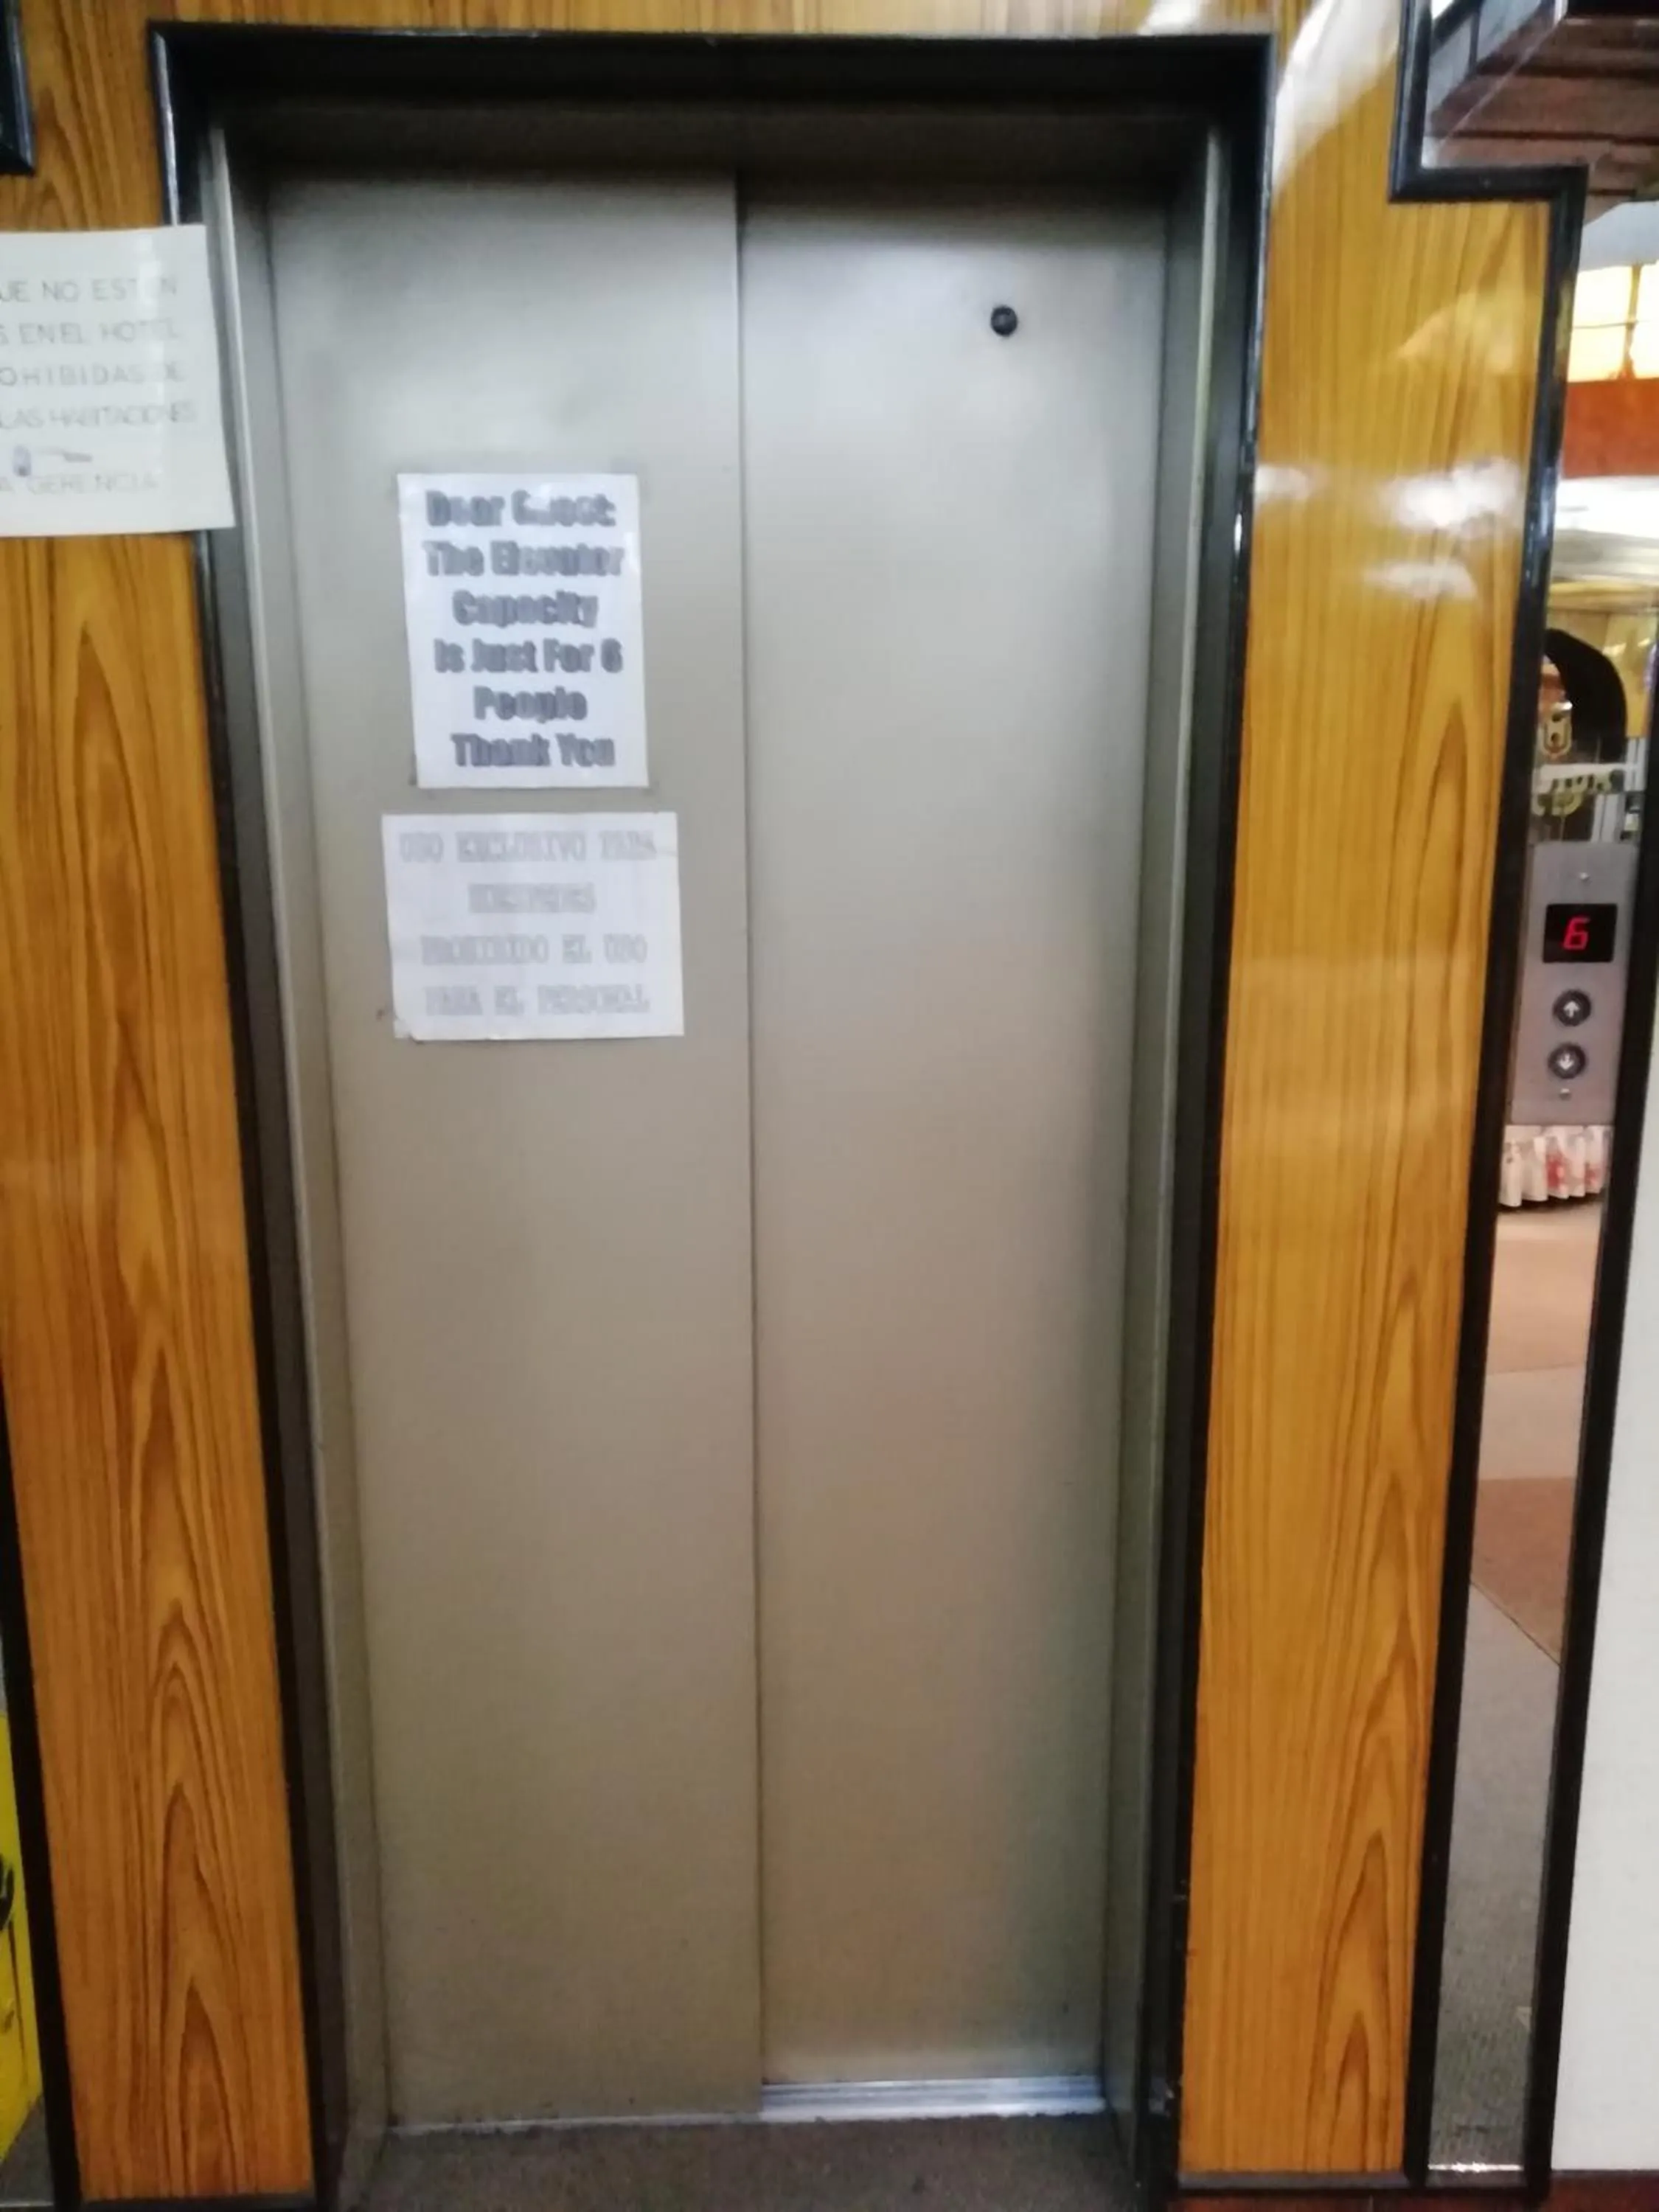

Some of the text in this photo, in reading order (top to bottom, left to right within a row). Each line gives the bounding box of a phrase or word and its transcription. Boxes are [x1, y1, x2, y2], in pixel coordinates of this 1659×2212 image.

[41, 279, 80, 302] NO
[422, 540, 484, 577] The
[452, 589, 599, 628] Capacity
[434, 638, 465, 673] Is
[471, 638, 538, 673] Just
[542, 638, 595, 673] For
[473, 686, 588, 723] People
[451, 733, 616, 768] Thank You
[1562, 916, 1590, 950] 6
